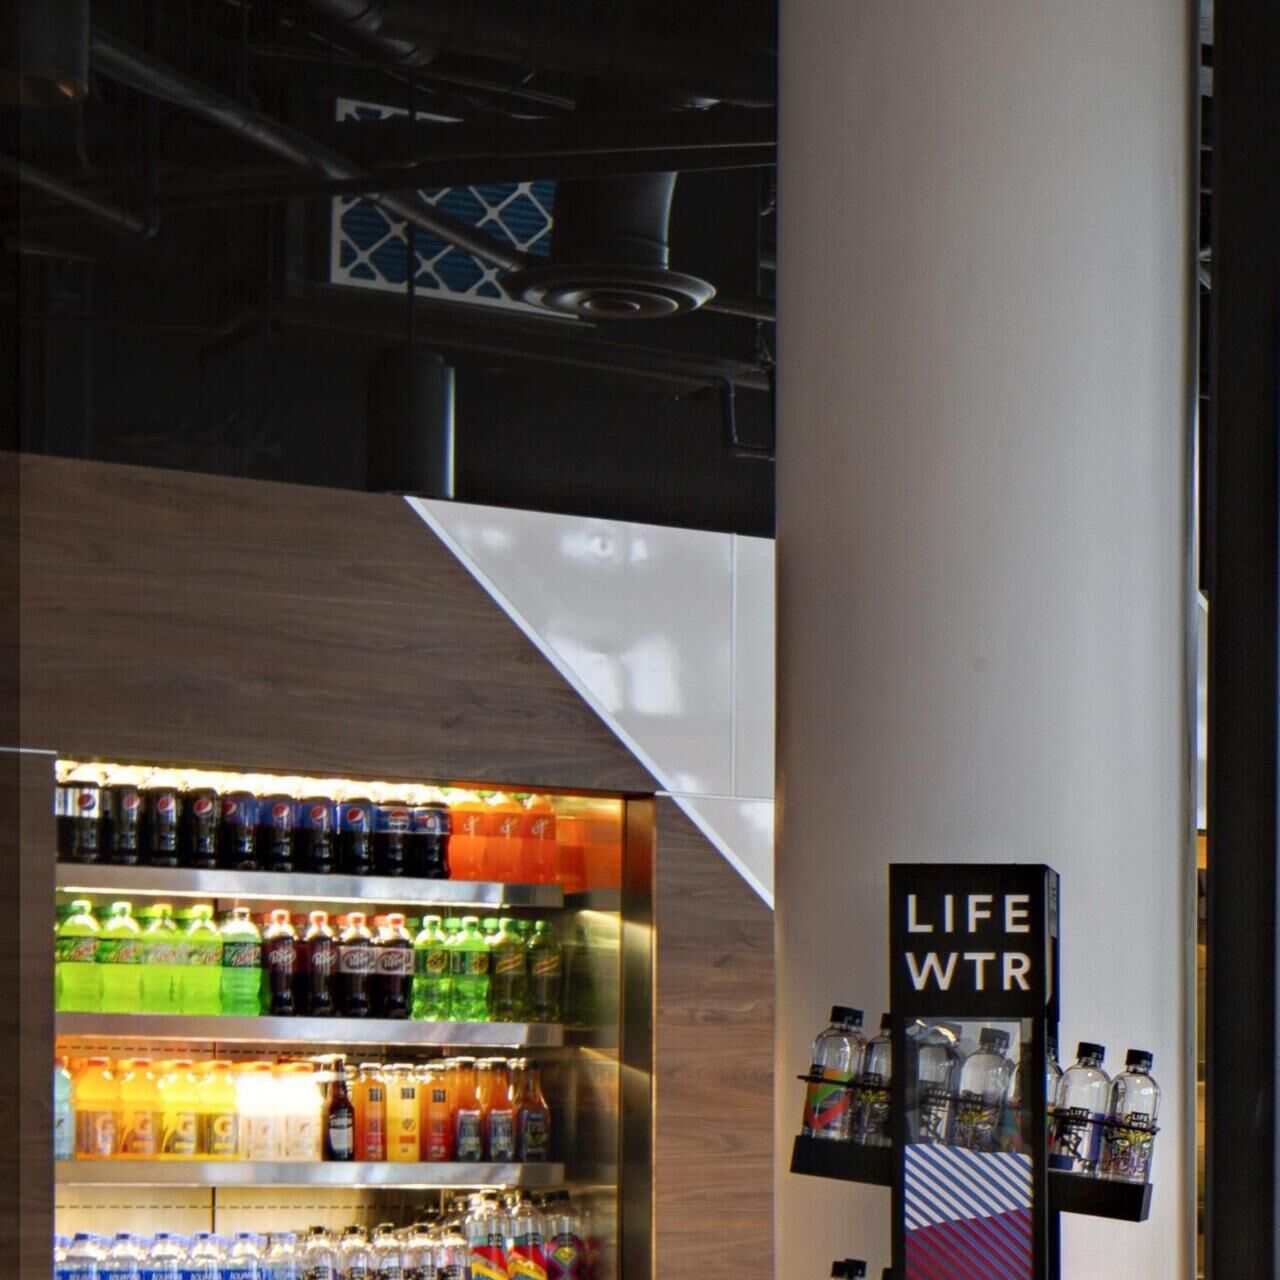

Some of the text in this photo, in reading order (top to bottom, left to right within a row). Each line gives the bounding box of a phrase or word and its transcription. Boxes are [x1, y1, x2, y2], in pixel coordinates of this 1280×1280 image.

[908, 894, 1030, 933] LIFE
[904, 952, 1031, 991] WTR
[1132, 1113, 1148, 1122] LIFE
